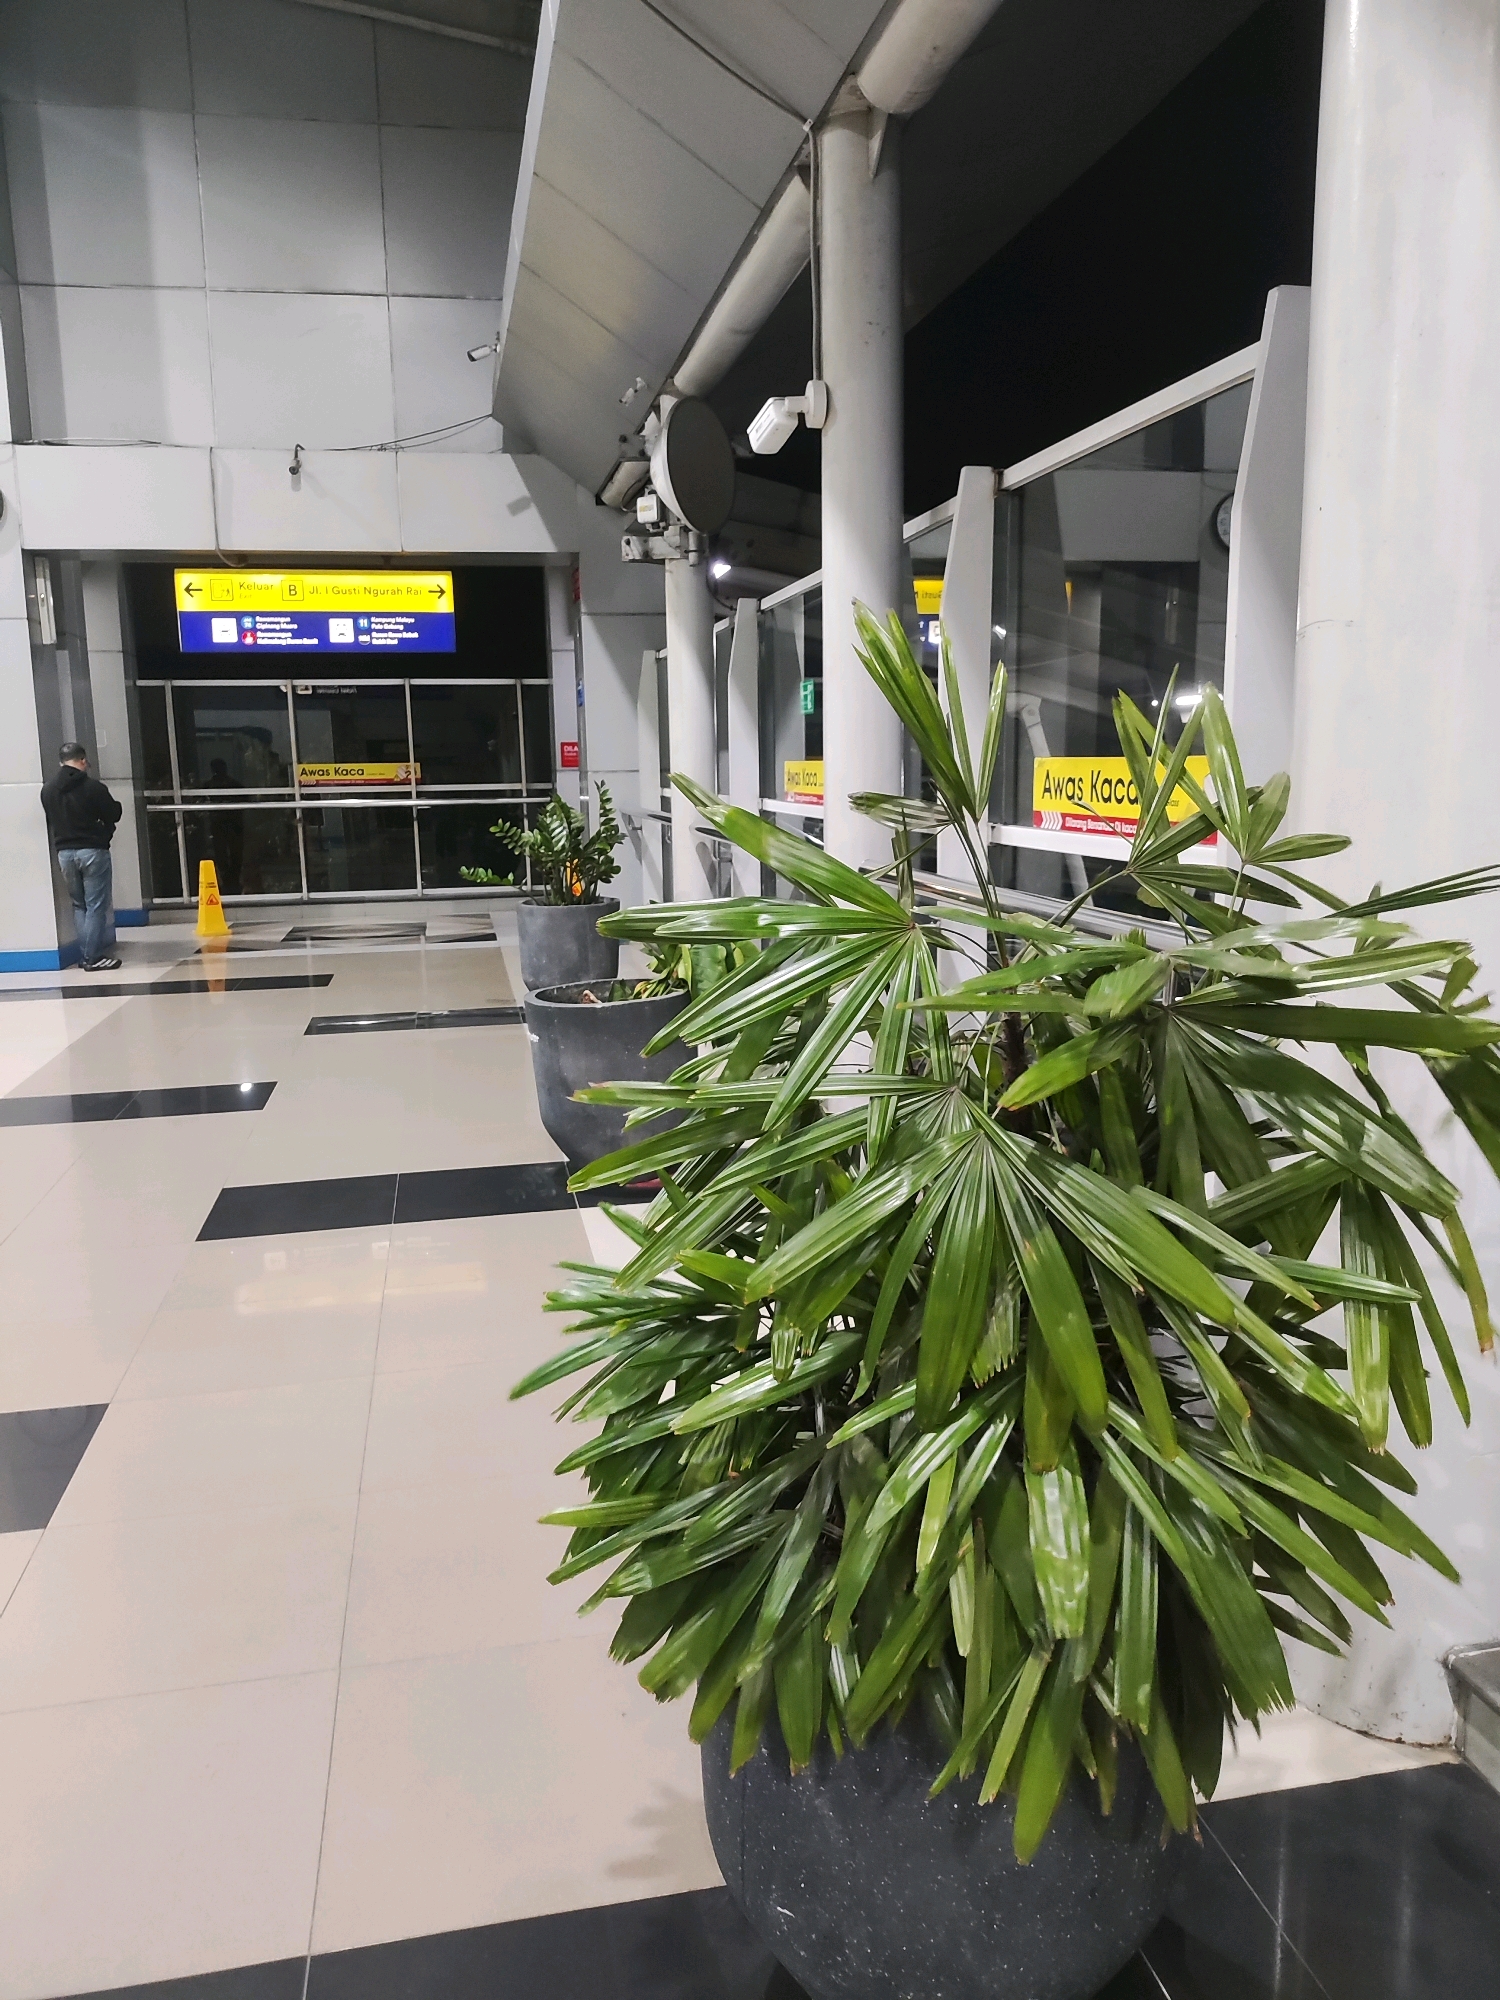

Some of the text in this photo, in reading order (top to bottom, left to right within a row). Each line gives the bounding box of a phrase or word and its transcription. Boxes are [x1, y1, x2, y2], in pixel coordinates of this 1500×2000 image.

[238, 582, 274, 591] Keluar
[288, 584, 298, 596] B
[309, 585, 322, 595] Jl.
[331, 585, 360, 595] Gusti
[363, 586, 403, 598] Ngurah
[406, 586, 422, 596] Rai
[358, 619, 368, 628] 11
[299, 766, 365, 777] Awas Kaca
[1041, 769, 1139, 805] Awas Kaca
